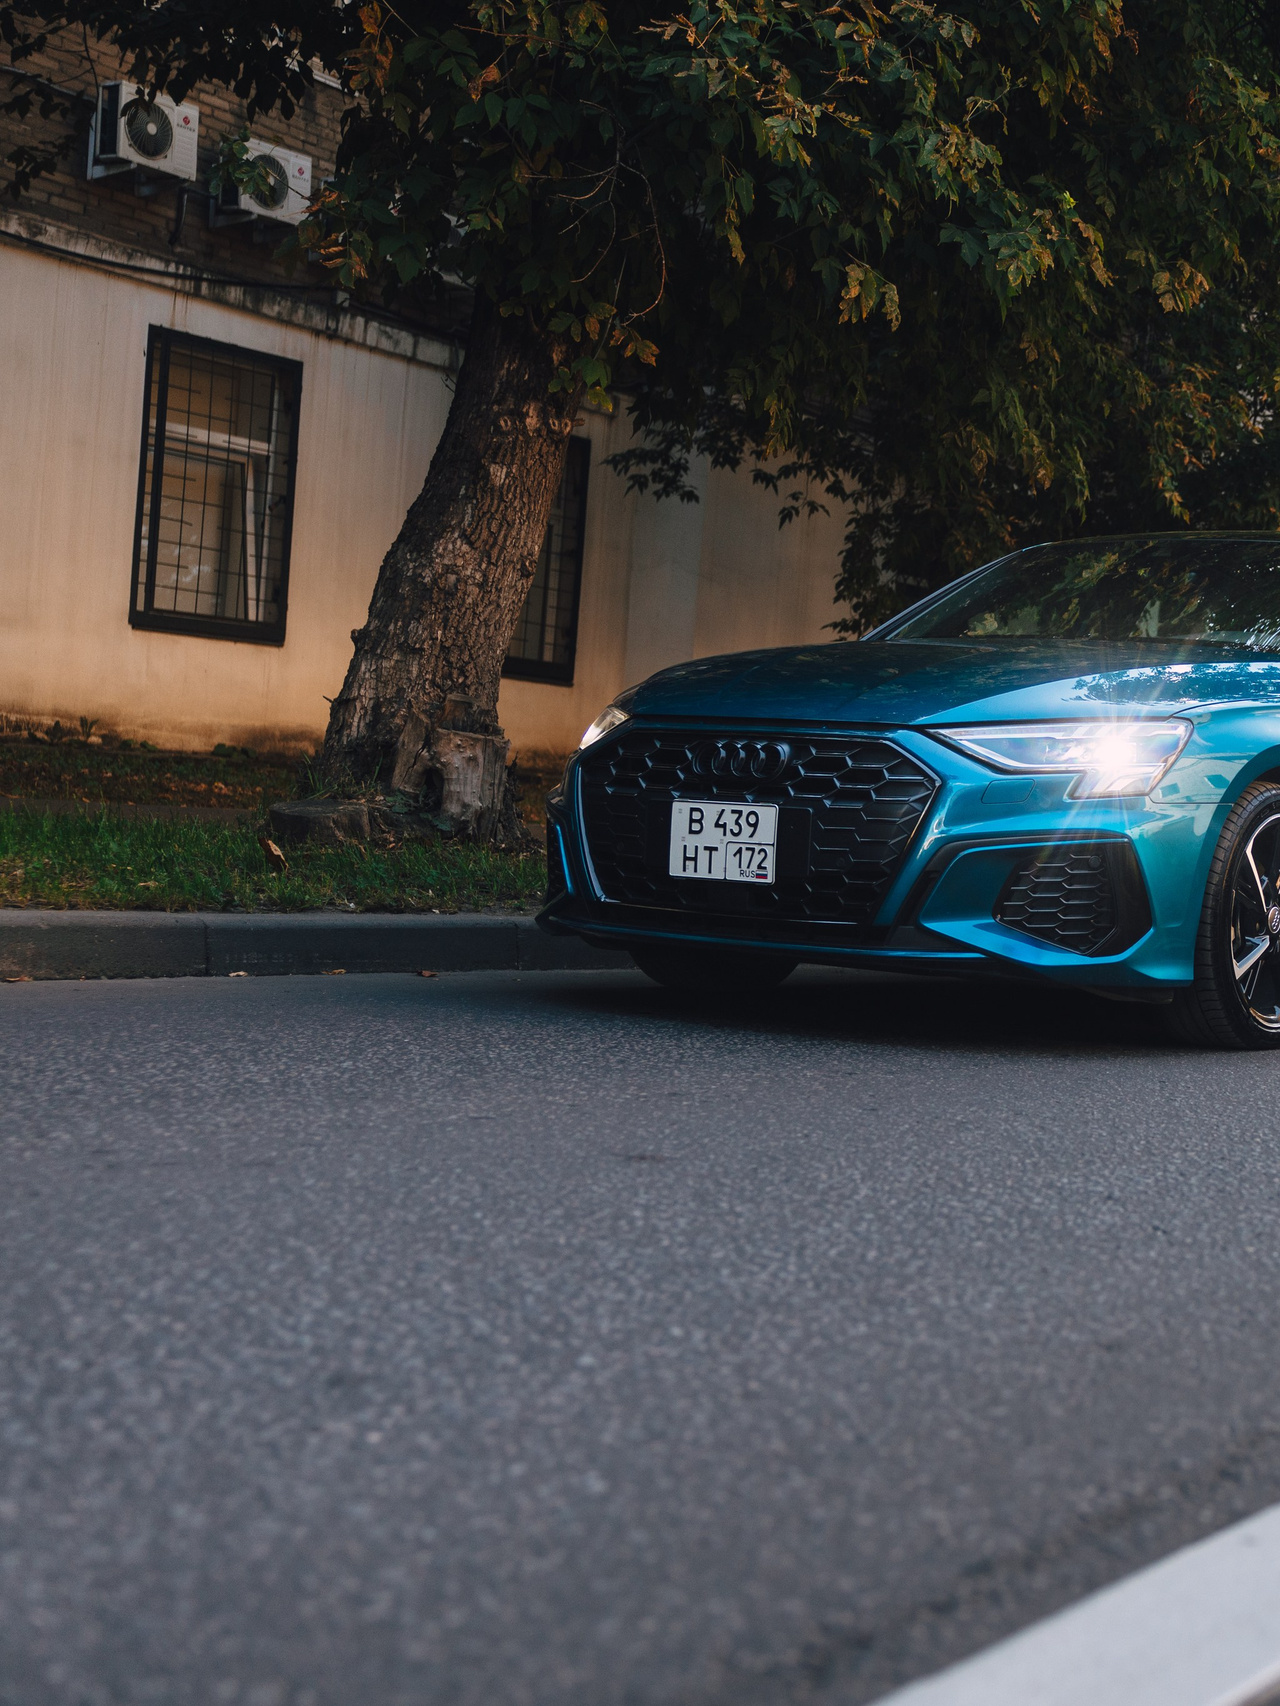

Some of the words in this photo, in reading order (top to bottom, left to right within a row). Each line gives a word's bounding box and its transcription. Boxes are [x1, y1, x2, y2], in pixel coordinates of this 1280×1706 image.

[714, 808, 760, 838] 439
[732, 846, 768, 870] 172
[739, 869, 756, 878] RUS
